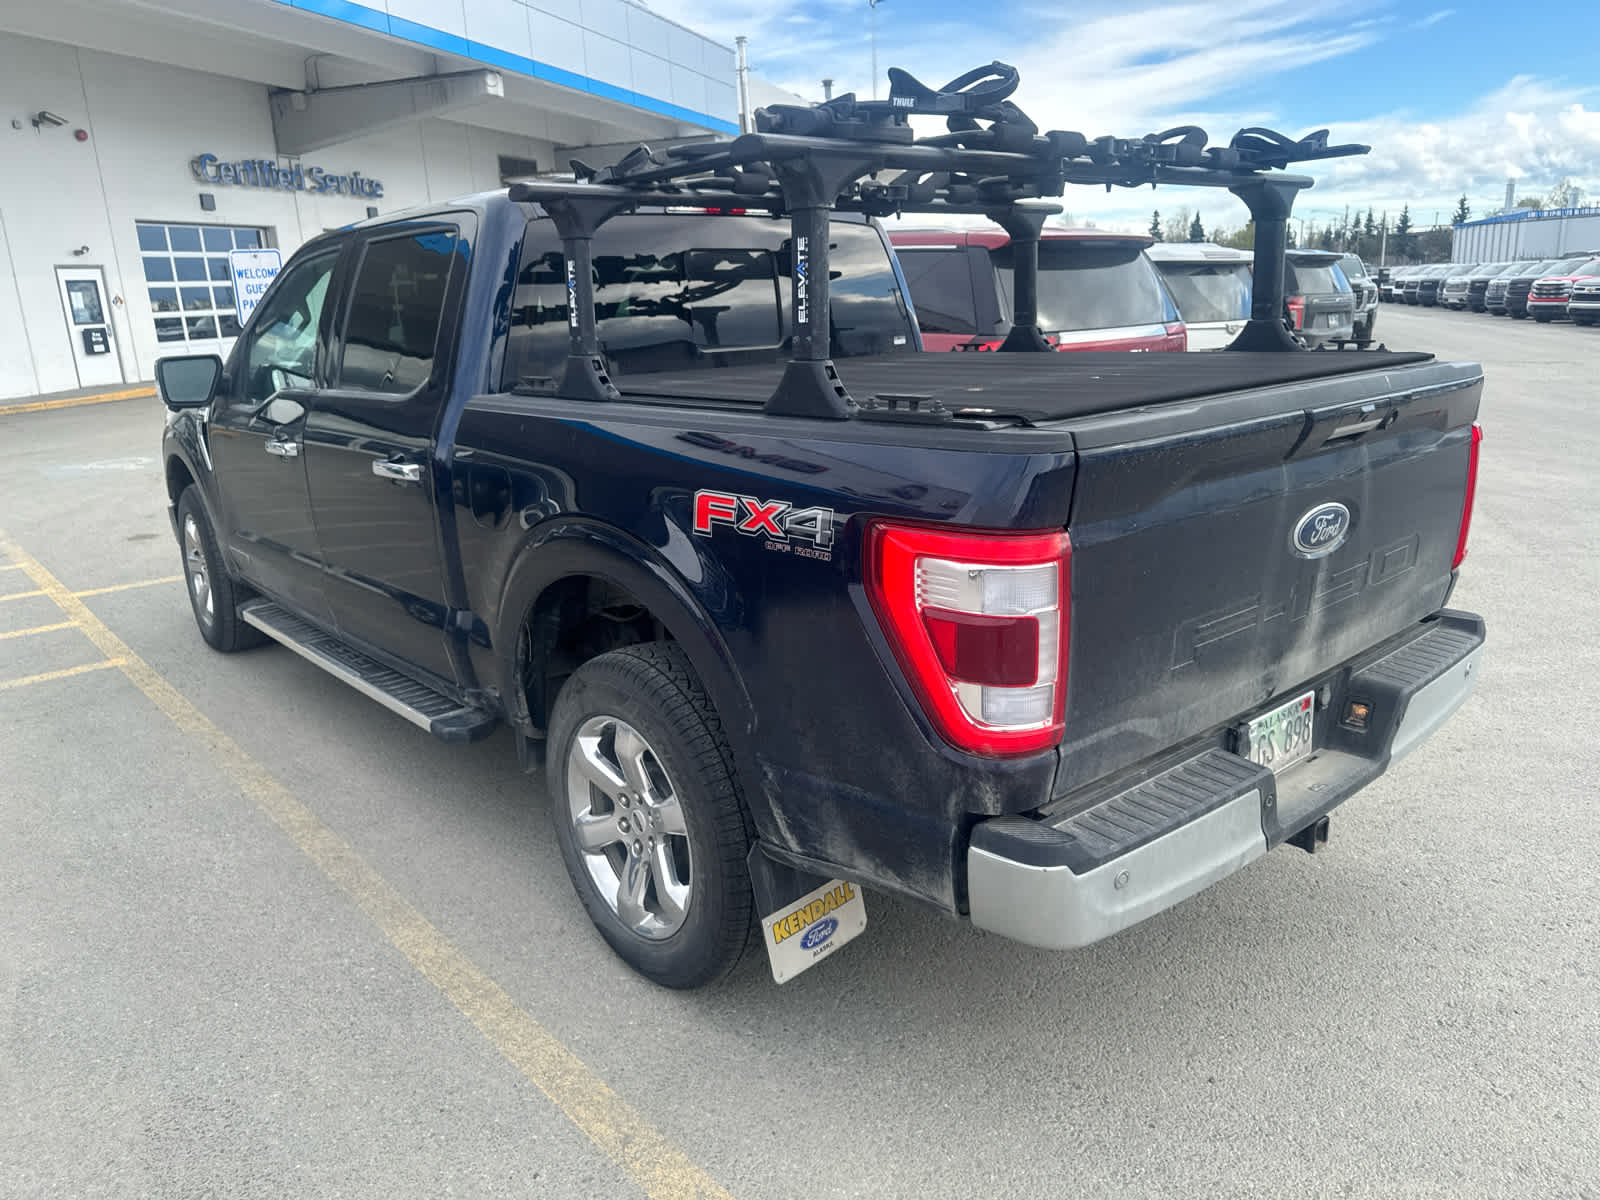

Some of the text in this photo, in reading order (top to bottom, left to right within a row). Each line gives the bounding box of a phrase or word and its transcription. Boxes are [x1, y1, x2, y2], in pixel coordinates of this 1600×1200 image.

[892, 96, 914, 107] THULE
[197, 153, 384, 198] Certified Service
[567, 260, 578, 327] ELEVATE
[796, 237, 807, 323] ELEVATE
[693, 489, 834, 551] FX4
[1285, 712, 1310, 753] 898
[773, 882, 855, 944] KENDALL
